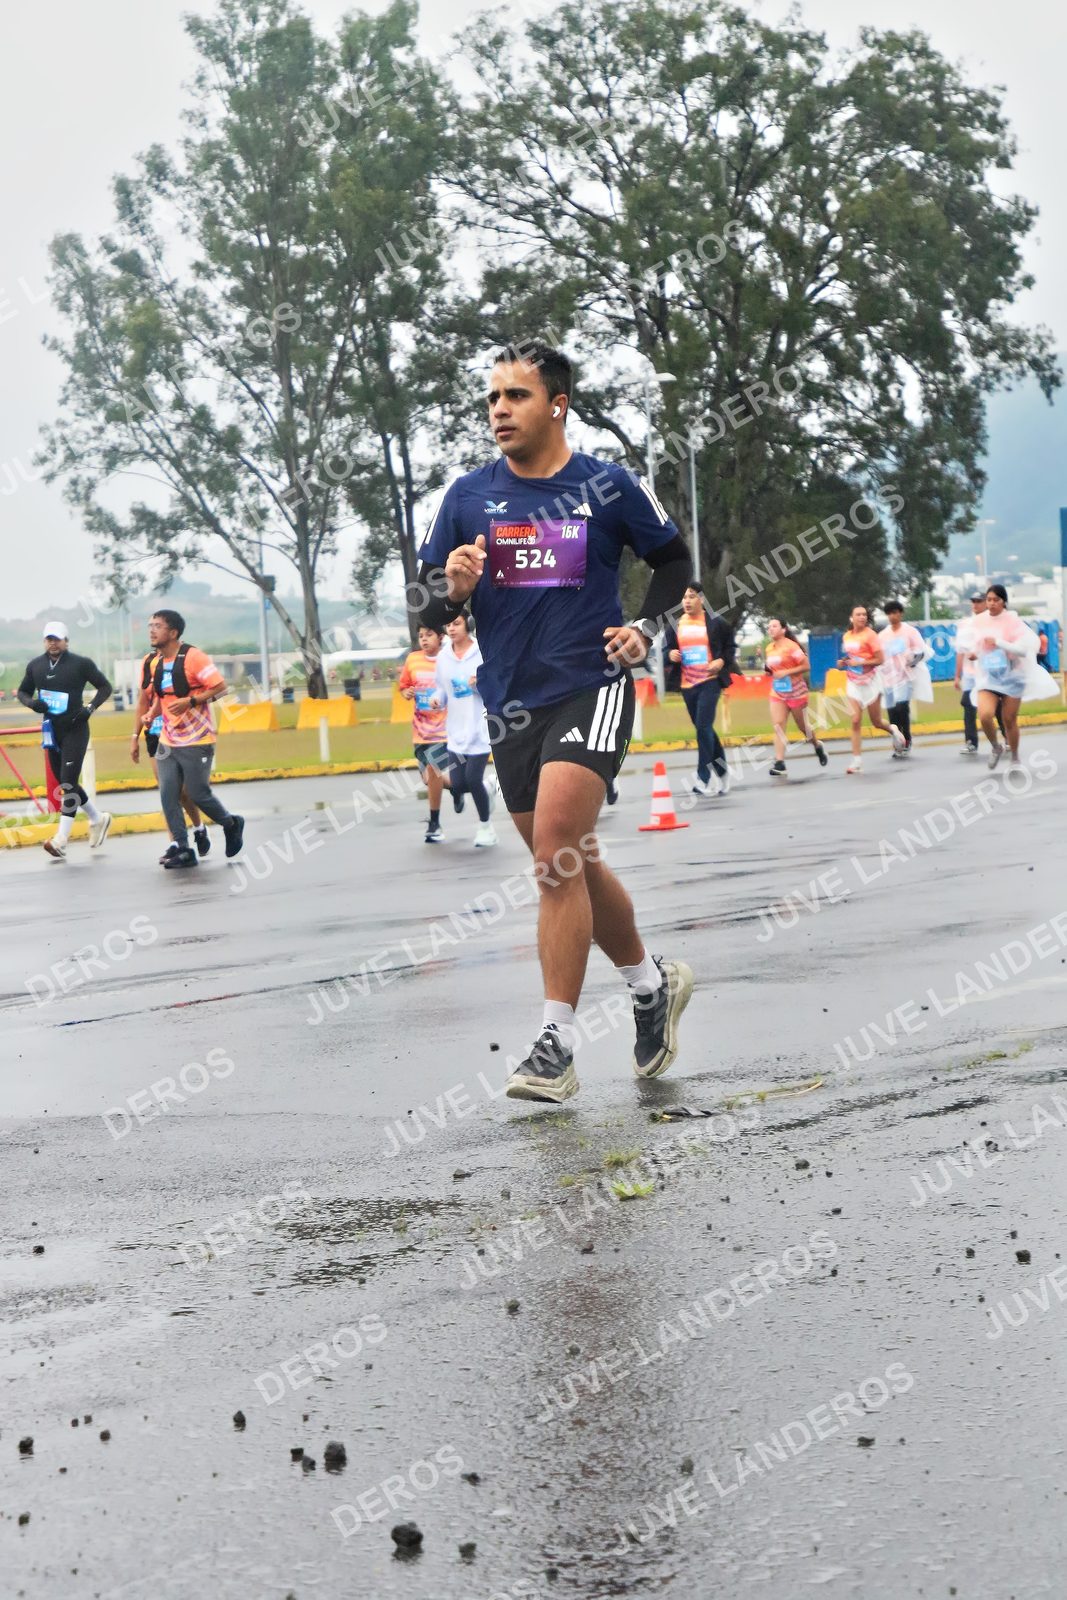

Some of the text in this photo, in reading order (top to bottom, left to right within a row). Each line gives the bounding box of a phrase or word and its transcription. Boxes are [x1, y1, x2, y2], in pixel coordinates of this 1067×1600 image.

[496, 526, 537, 537] CARRERA
[561, 525, 580, 539] 16K
[496, 537, 527, 545] OMNILIFE
[515, 549, 557, 569] 524
